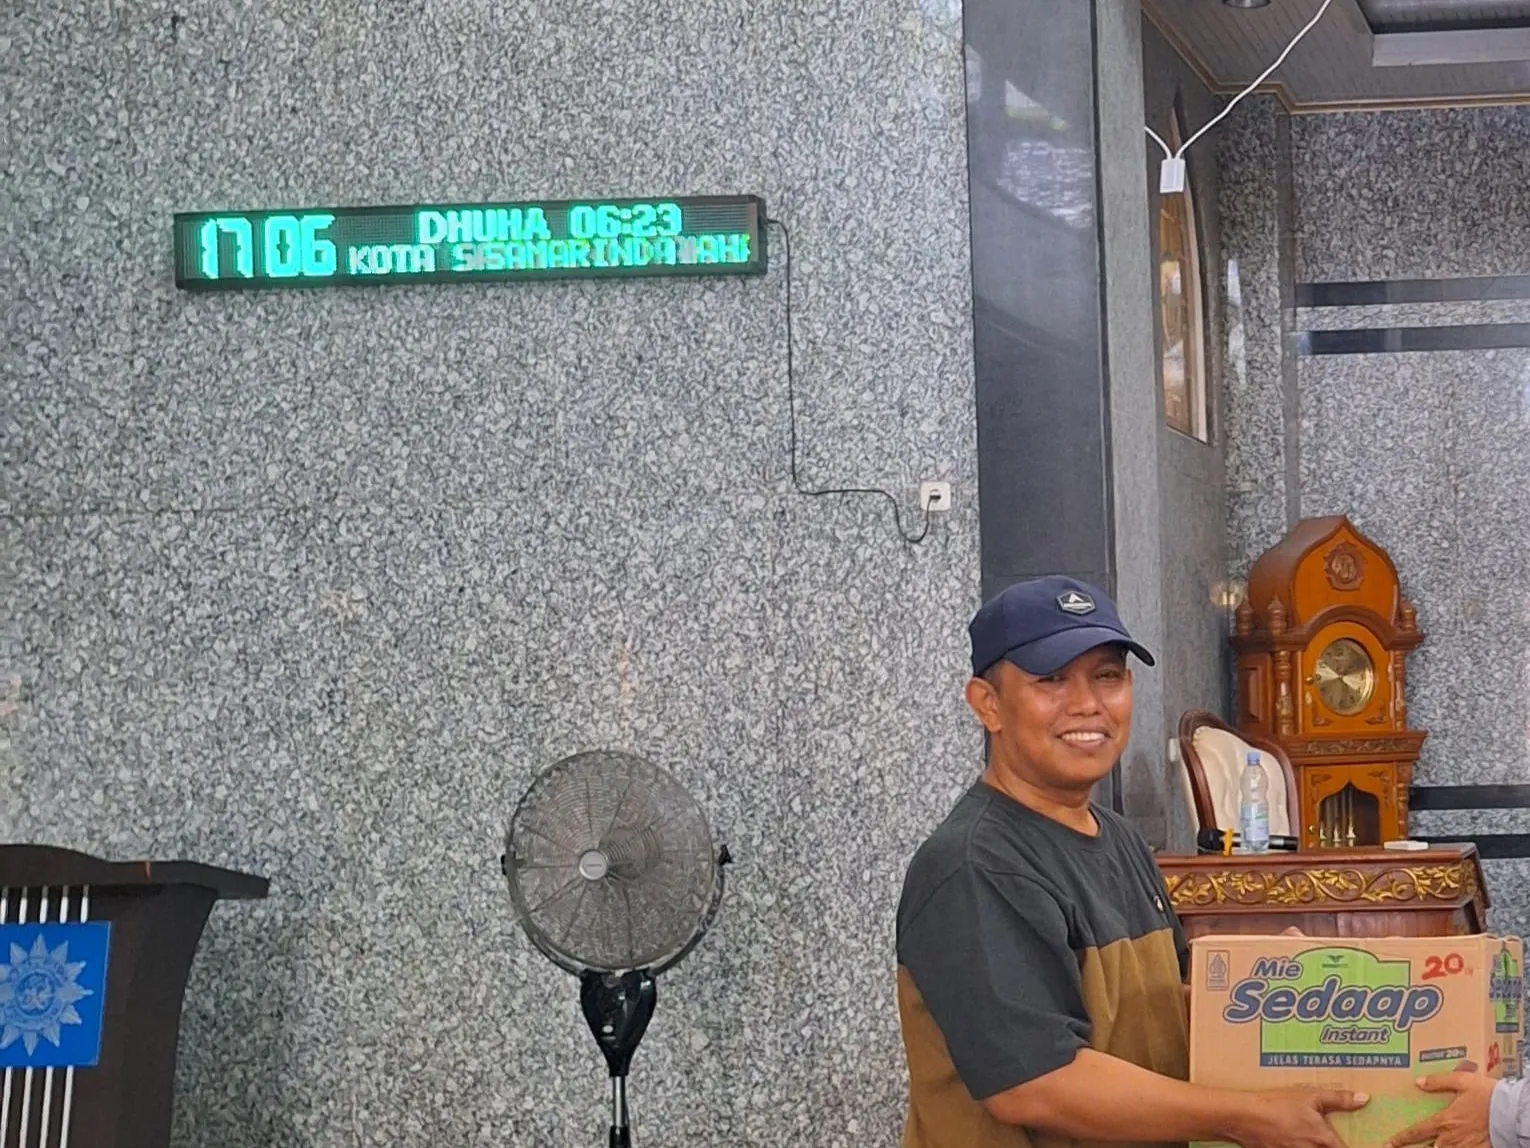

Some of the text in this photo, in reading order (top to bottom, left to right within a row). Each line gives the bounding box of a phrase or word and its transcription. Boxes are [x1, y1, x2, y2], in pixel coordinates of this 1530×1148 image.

[418, 203, 683, 244] DHUHA 06:23
[349, 243, 436, 275] KOTA
[1252, 957, 1302, 980] Mie
[1224, 976, 1442, 1031] Sedaap
[1321, 1026, 1390, 1043] Instant
[1267, 1055, 1403, 1066] JELAS TERASA SEDAPNYA
